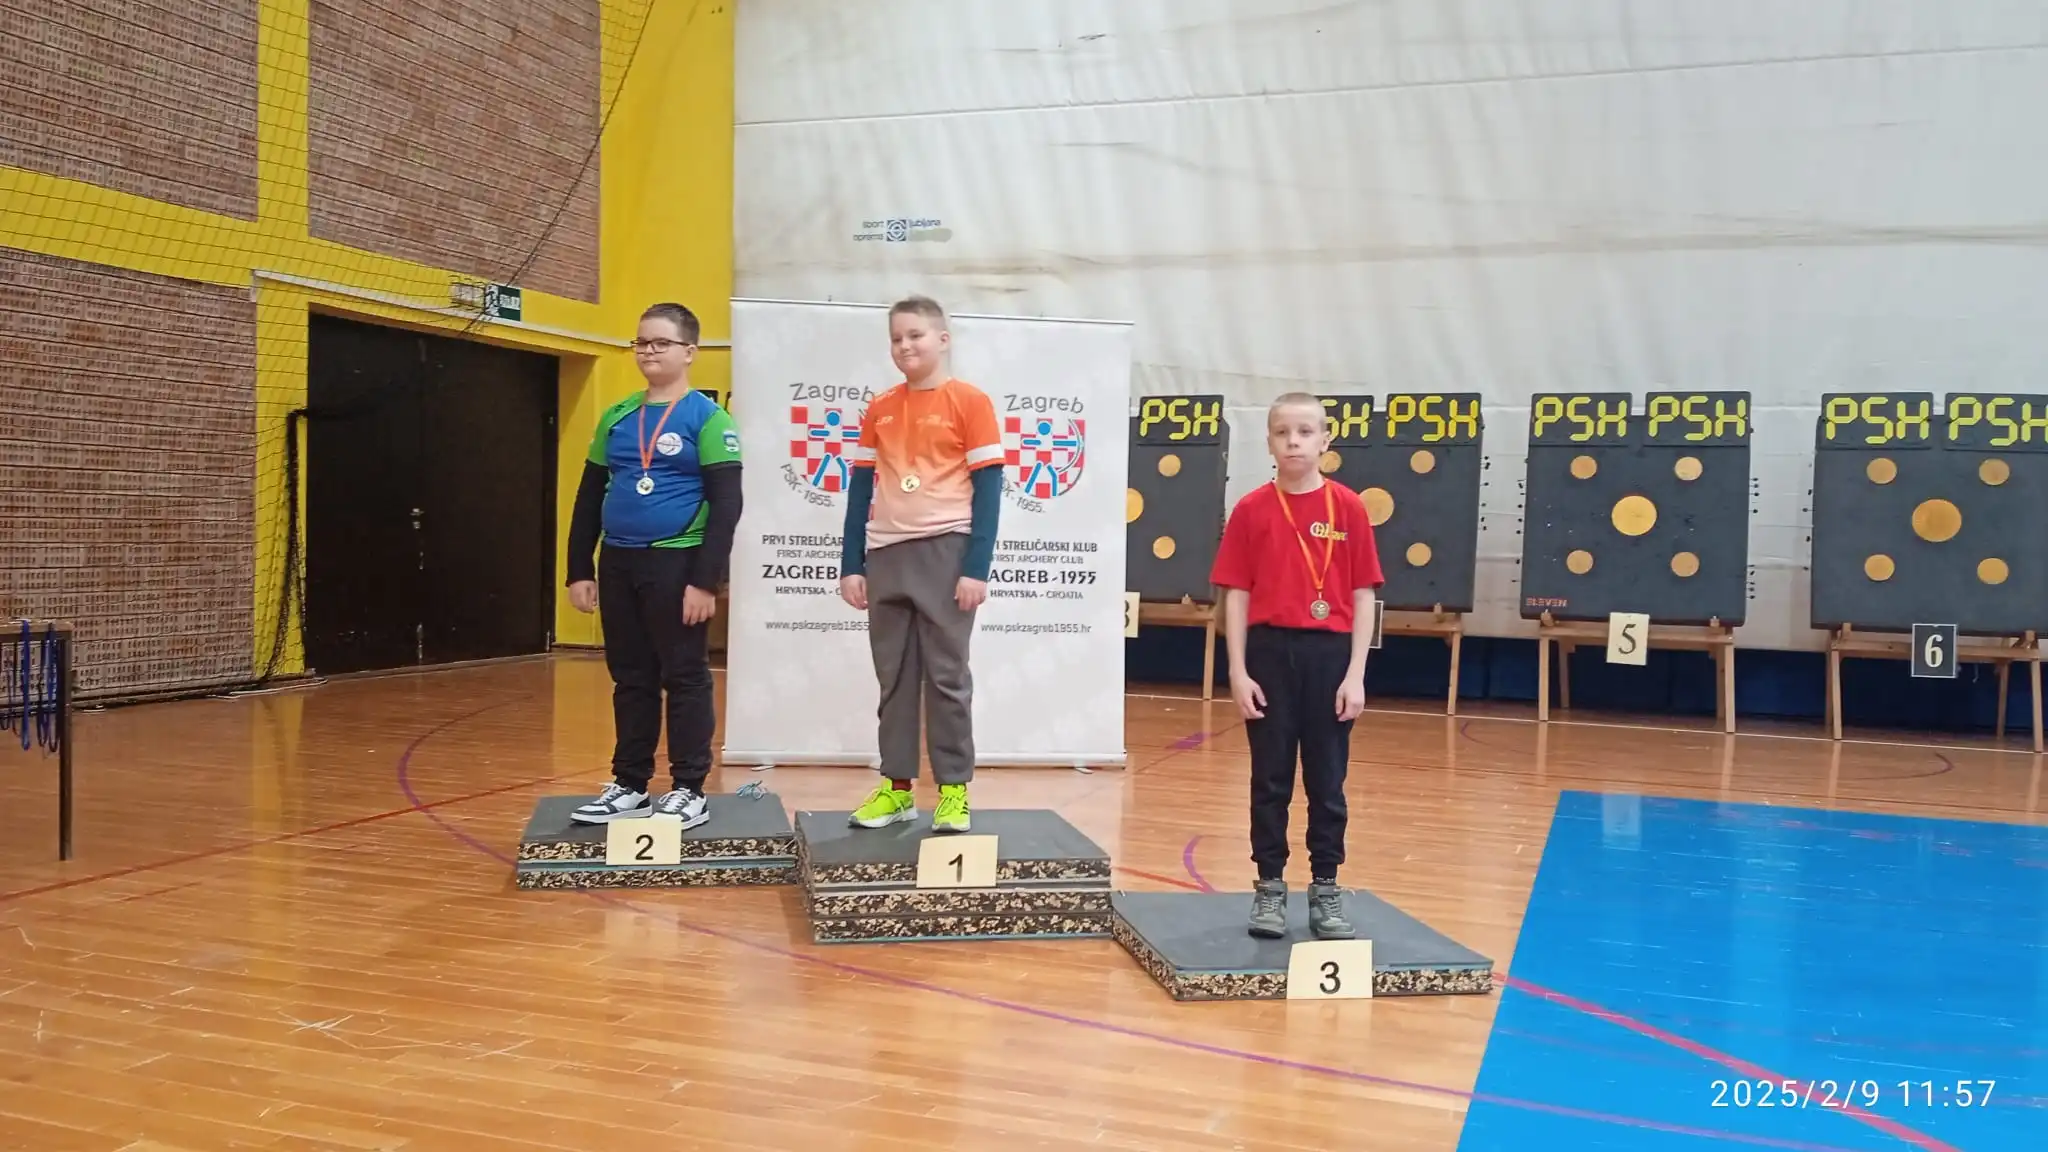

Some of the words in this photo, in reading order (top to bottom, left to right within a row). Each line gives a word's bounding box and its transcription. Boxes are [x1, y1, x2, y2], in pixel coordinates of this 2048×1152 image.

[789, 382, 874, 403] Zagreb
[1003, 394, 1084, 414] Zagreb
[1319, 399, 1370, 440] SH
[762, 534, 786, 545] PRVI
[788, 533, 844, 547] STRELIČAR
[1003, 538, 1070, 552] STRELIČARSKI
[1073, 542, 1098, 552] KLUB
[776, 549, 802, 559] FIRST
[804, 550, 843, 560] ARCHER
[1017, 554, 1058, 564] ARCHERY
[1060, 555, 1084, 565] CLUB
[762, 564, 838, 580] ZAGREB
[990, 569, 1048, 583] AGREB
[1060, 570, 1097, 585] 1955
[775, 586, 826, 596] HRVATSKA
[990, 589, 1038, 599] HRVATSKA
[1046, 590, 1084, 600] CROATIA
[1618, 624, 1636, 654] 5
[1924, 634, 1943, 667] 6
[635, 834, 654, 861] 2
[948, 853, 963, 883] 1
[1319, 961, 1341, 994] 3
